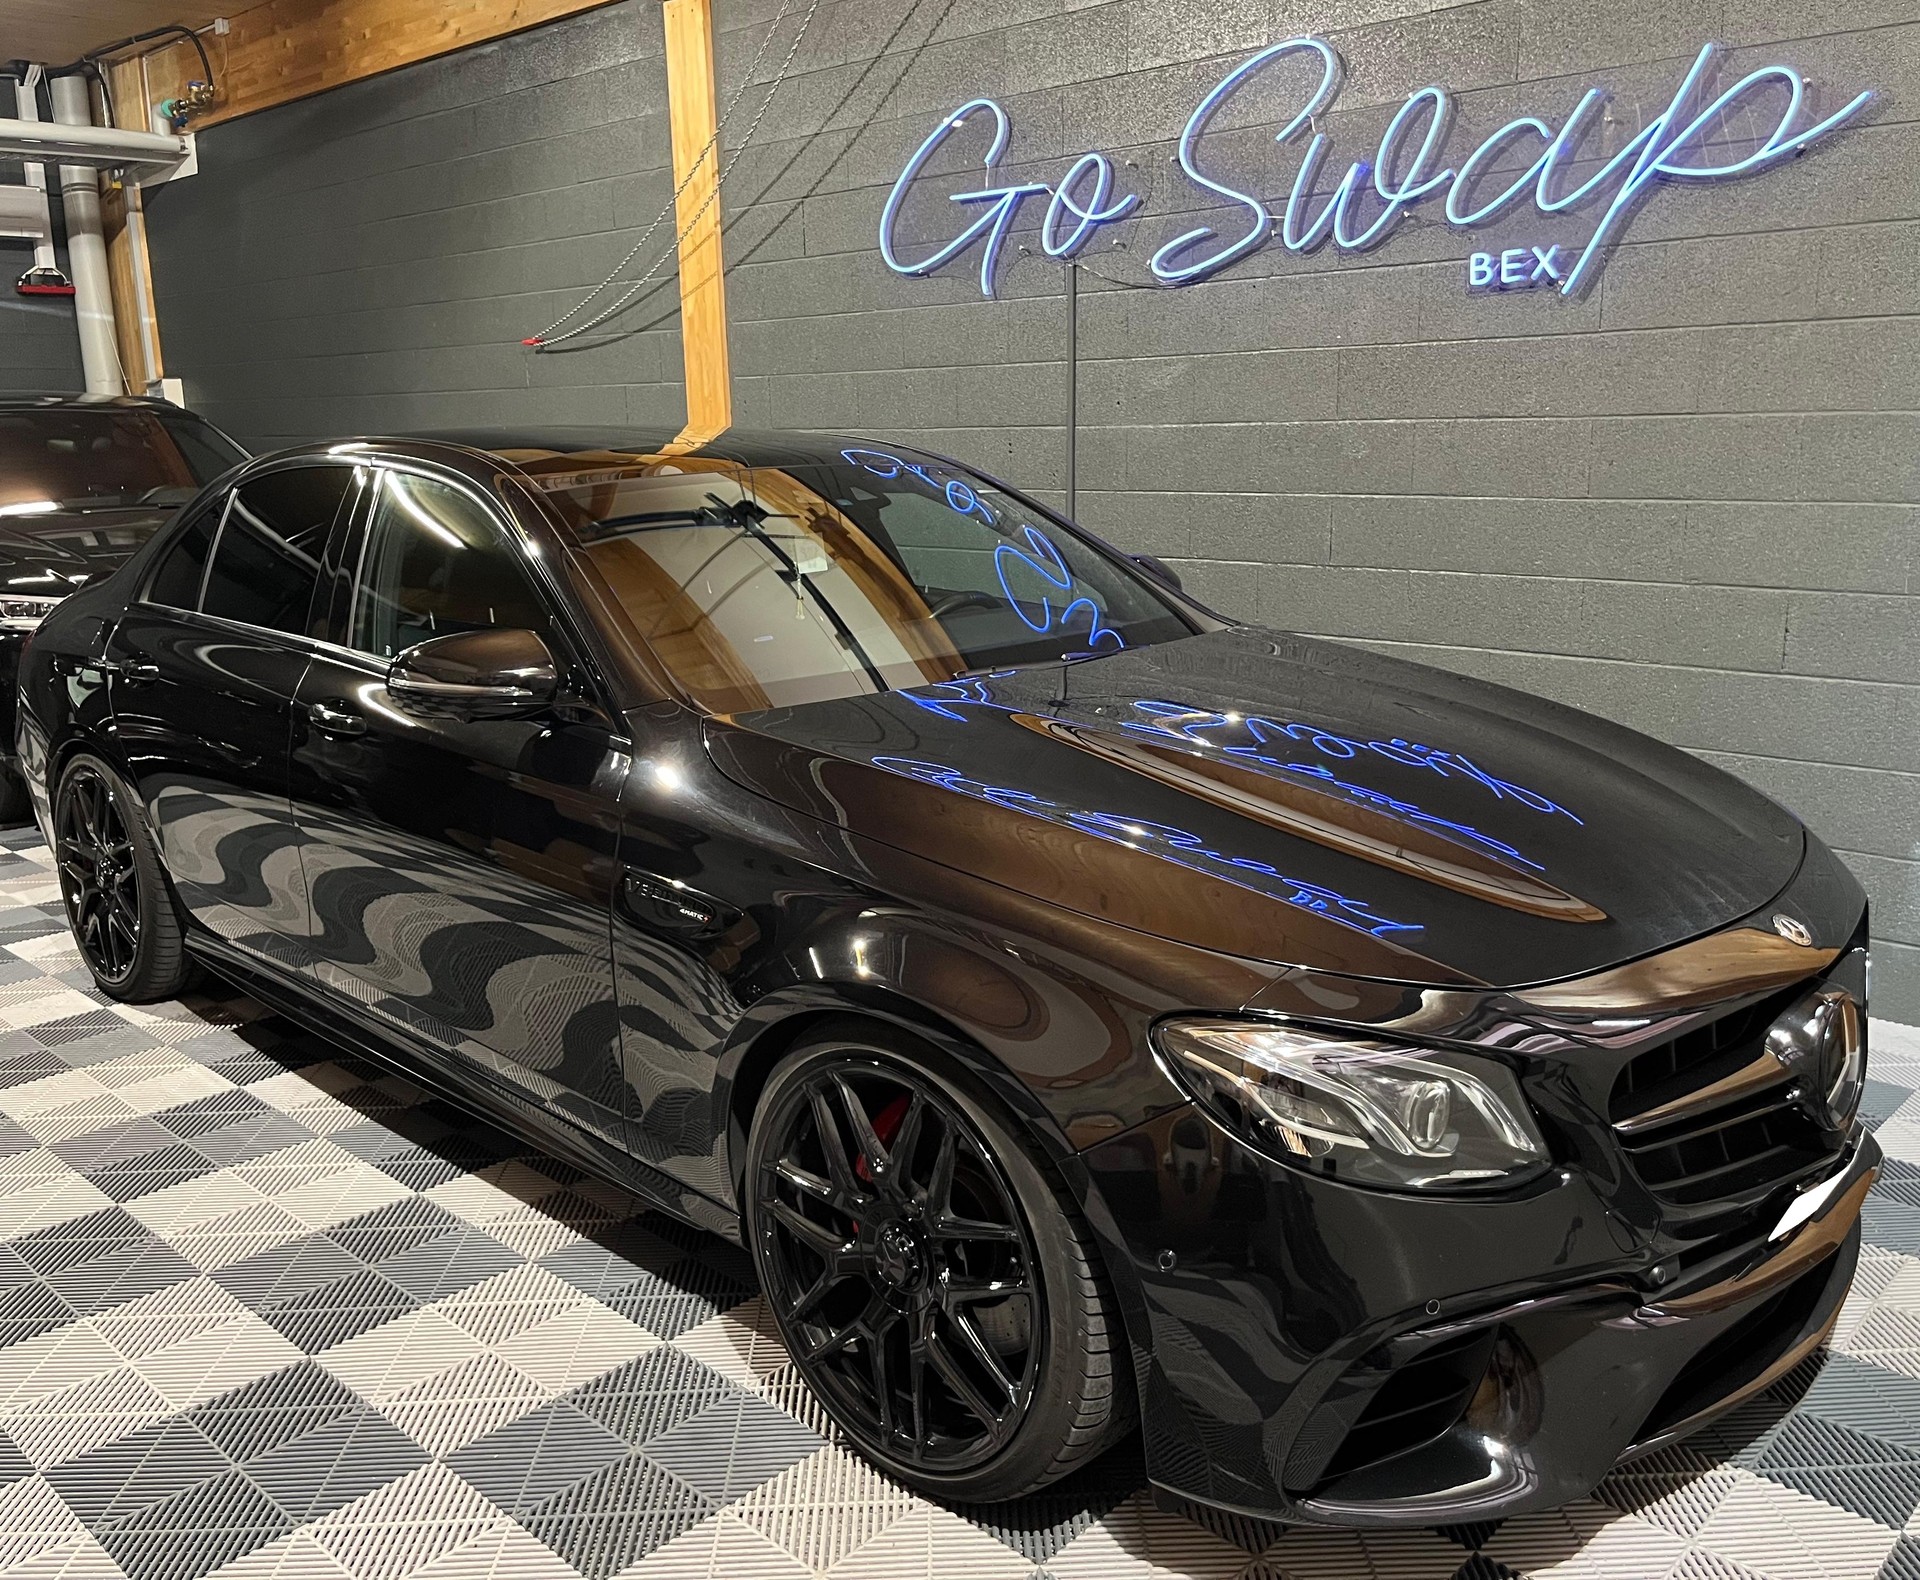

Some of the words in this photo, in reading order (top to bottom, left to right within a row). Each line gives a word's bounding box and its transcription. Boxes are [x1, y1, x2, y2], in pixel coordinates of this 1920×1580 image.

[879, 98, 1138, 297] Go
[1150, 37, 1874, 296] Swap
[1468, 243, 1561, 286] BEX
